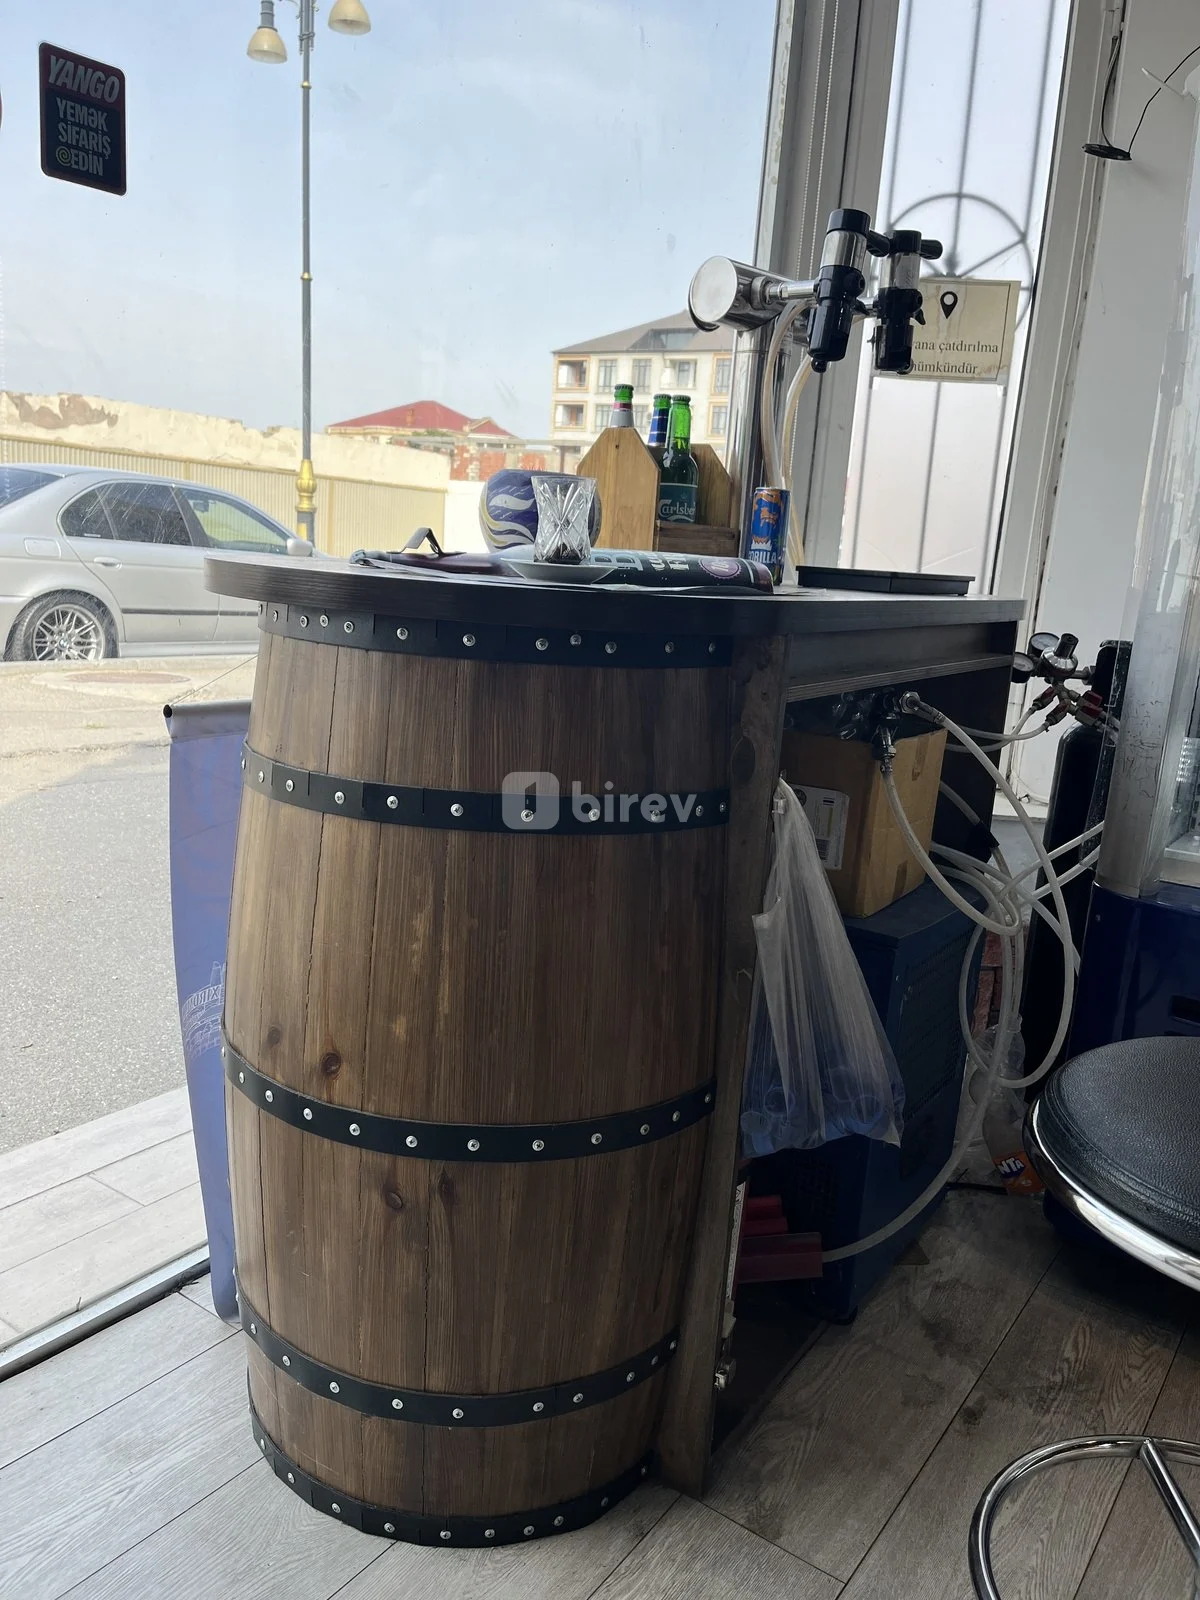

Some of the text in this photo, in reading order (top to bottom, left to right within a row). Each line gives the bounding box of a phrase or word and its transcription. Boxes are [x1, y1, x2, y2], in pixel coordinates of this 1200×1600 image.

[48, 55, 120, 103] YANGO
[58, 121, 111, 159] SİFARİŞ
[914, 340, 999, 353] ana çatdırılma
[997, 1157, 1025, 1174] NTA
